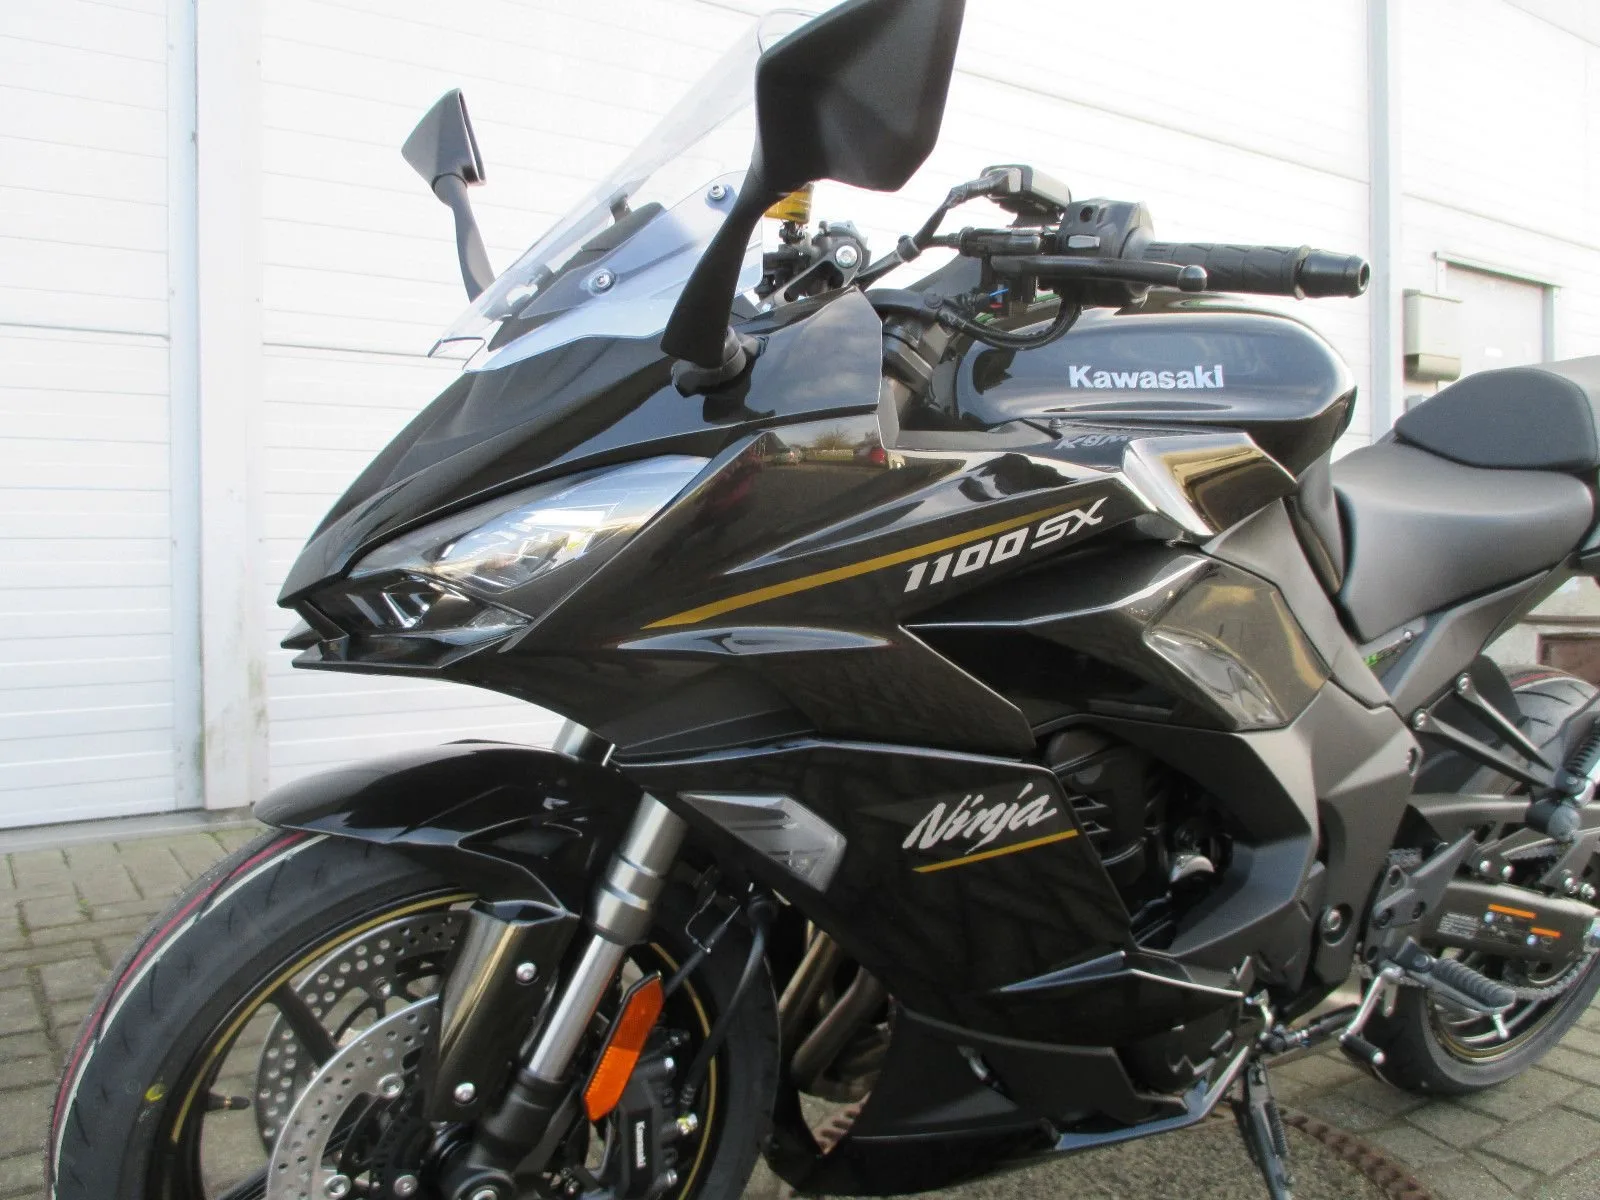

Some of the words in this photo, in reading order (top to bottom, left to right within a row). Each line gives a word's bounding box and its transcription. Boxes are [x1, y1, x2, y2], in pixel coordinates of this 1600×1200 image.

[1068, 364, 1224, 389] Kawasaki
[903, 527, 1029, 593] 1100
[1030, 496, 1109, 550] SX
[902, 782, 1057, 855] Ninja
